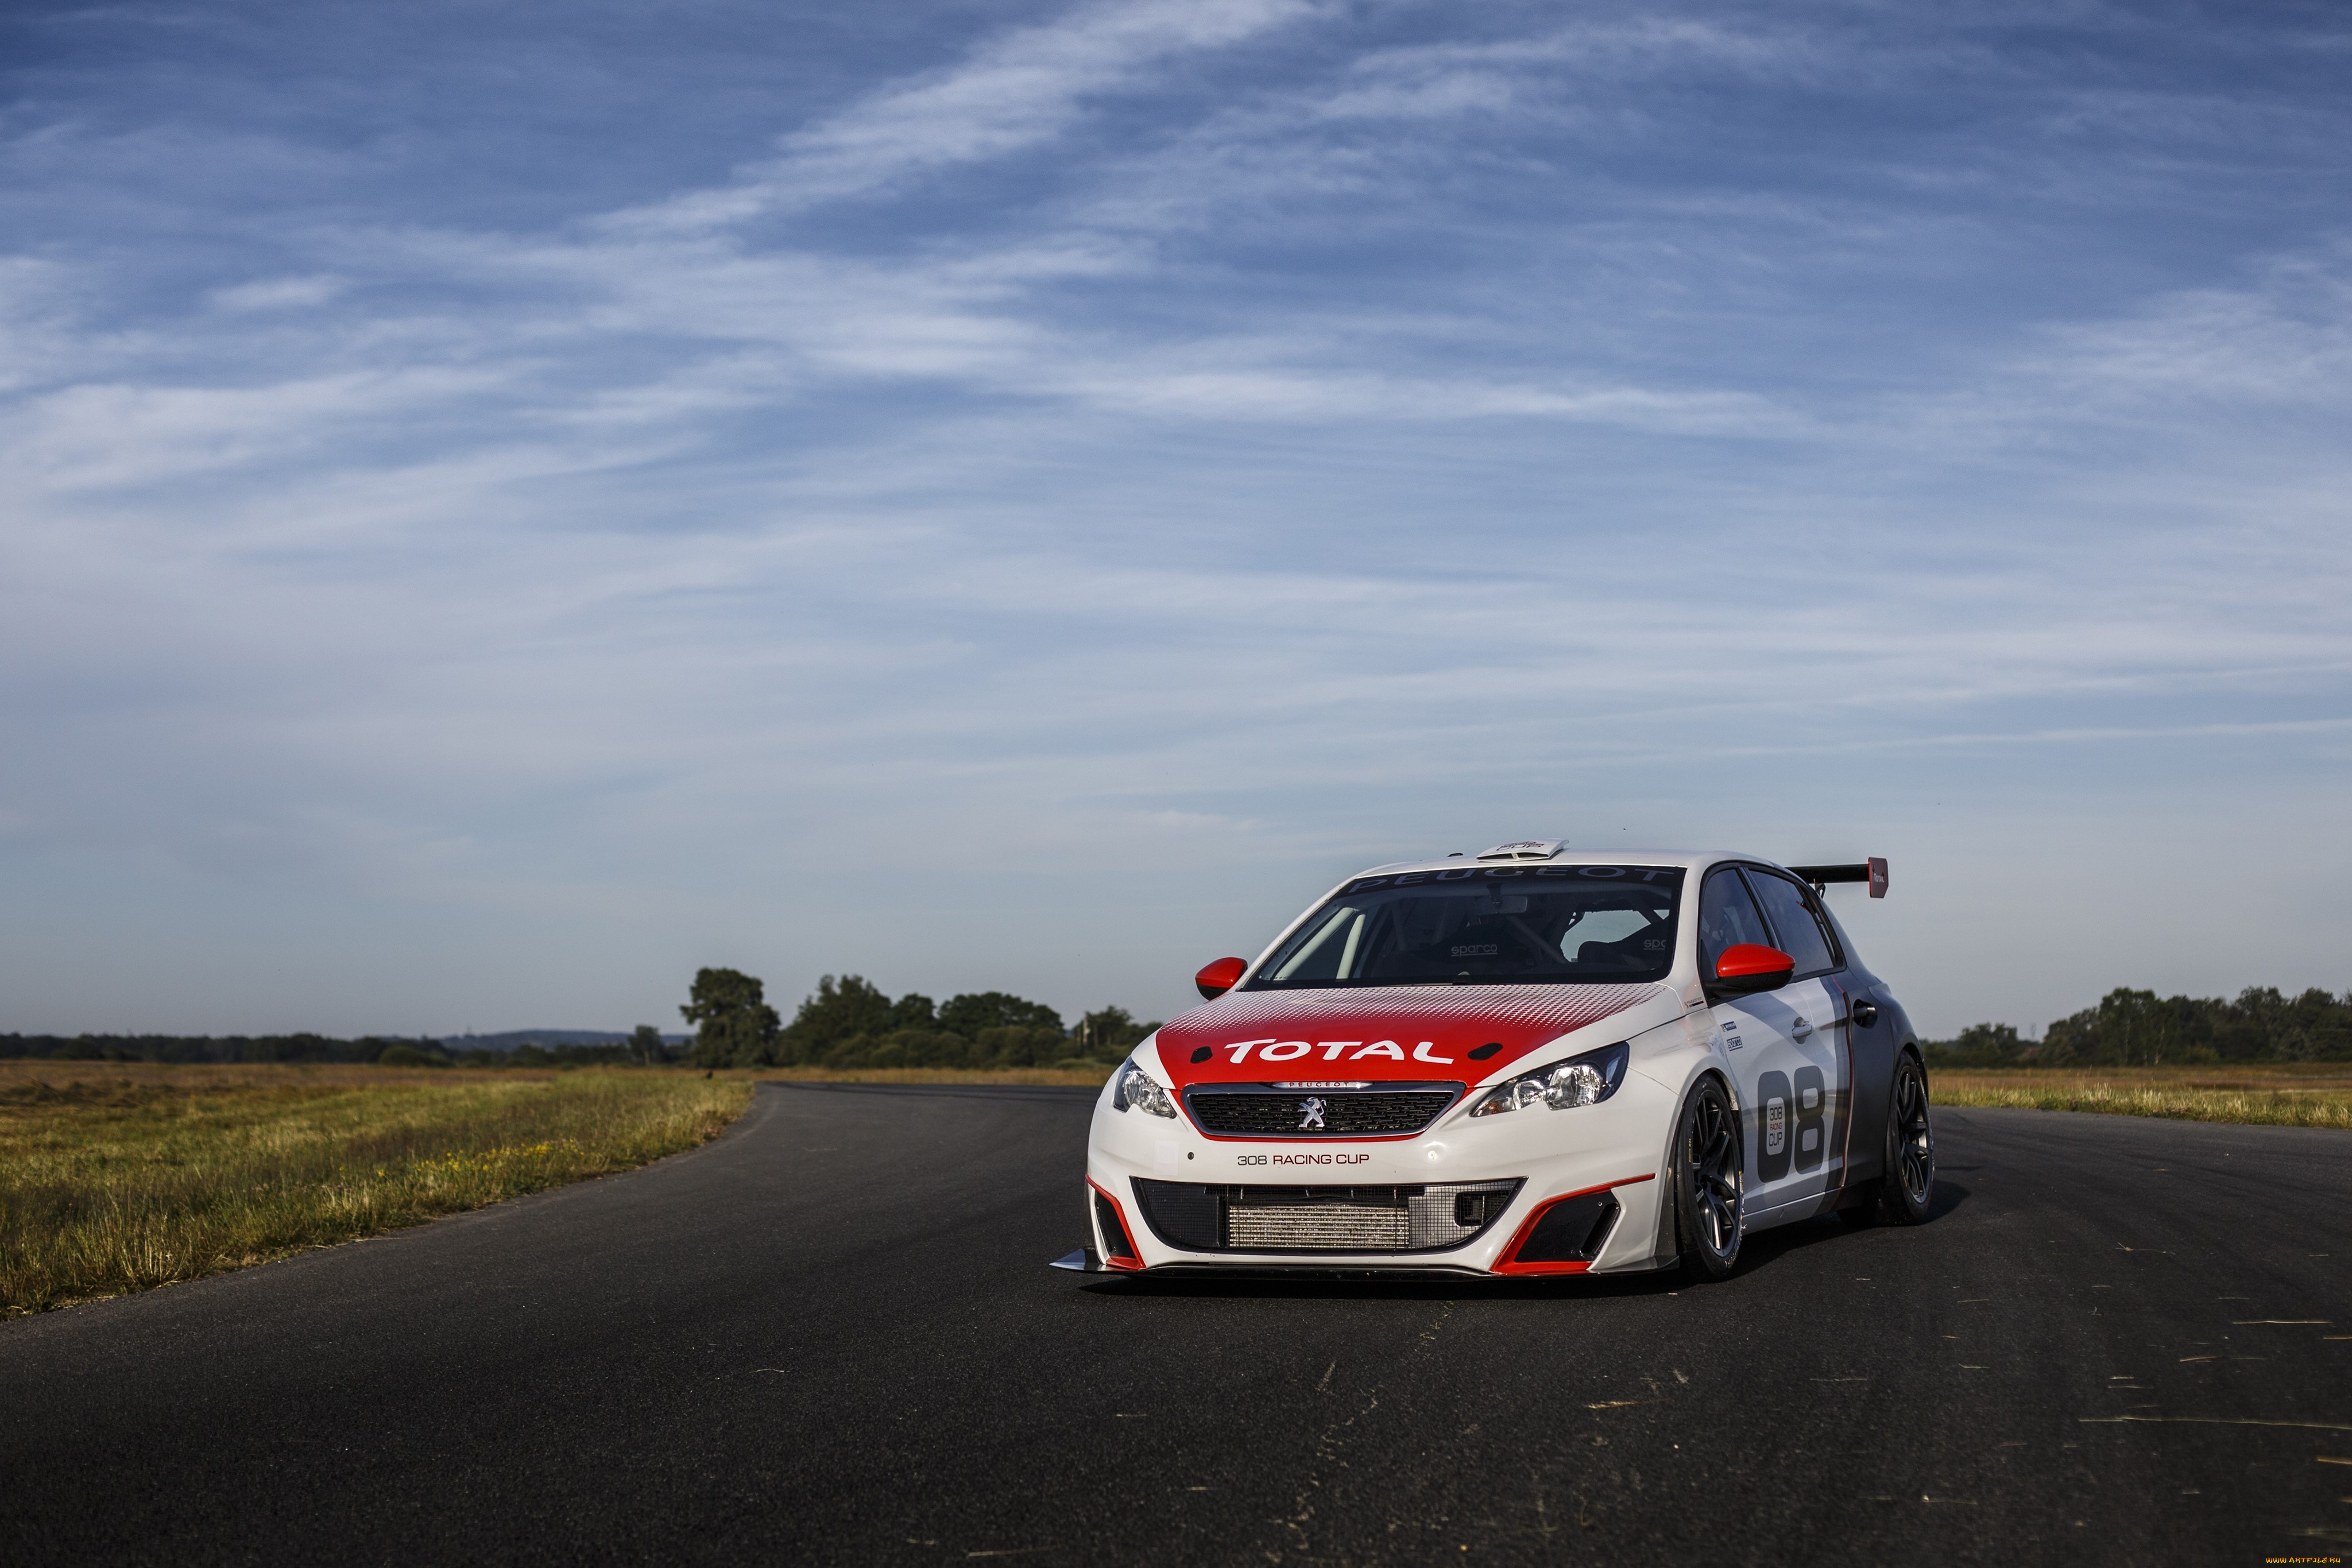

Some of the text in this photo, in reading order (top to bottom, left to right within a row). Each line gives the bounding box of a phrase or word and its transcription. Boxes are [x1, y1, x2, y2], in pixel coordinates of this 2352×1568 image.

[1349, 866, 1674, 893] PEUGEOT
[1451, 944, 1498, 957] sparco
[1224, 1039, 1454, 1064] TOTAL
[1769, 1106, 1782, 1120] 308
[1757, 1065, 1825, 1183] 08
[1769, 1132, 1782, 1147] CUP
[1237, 1154, 1370, 1166] 308 RACING CUP
